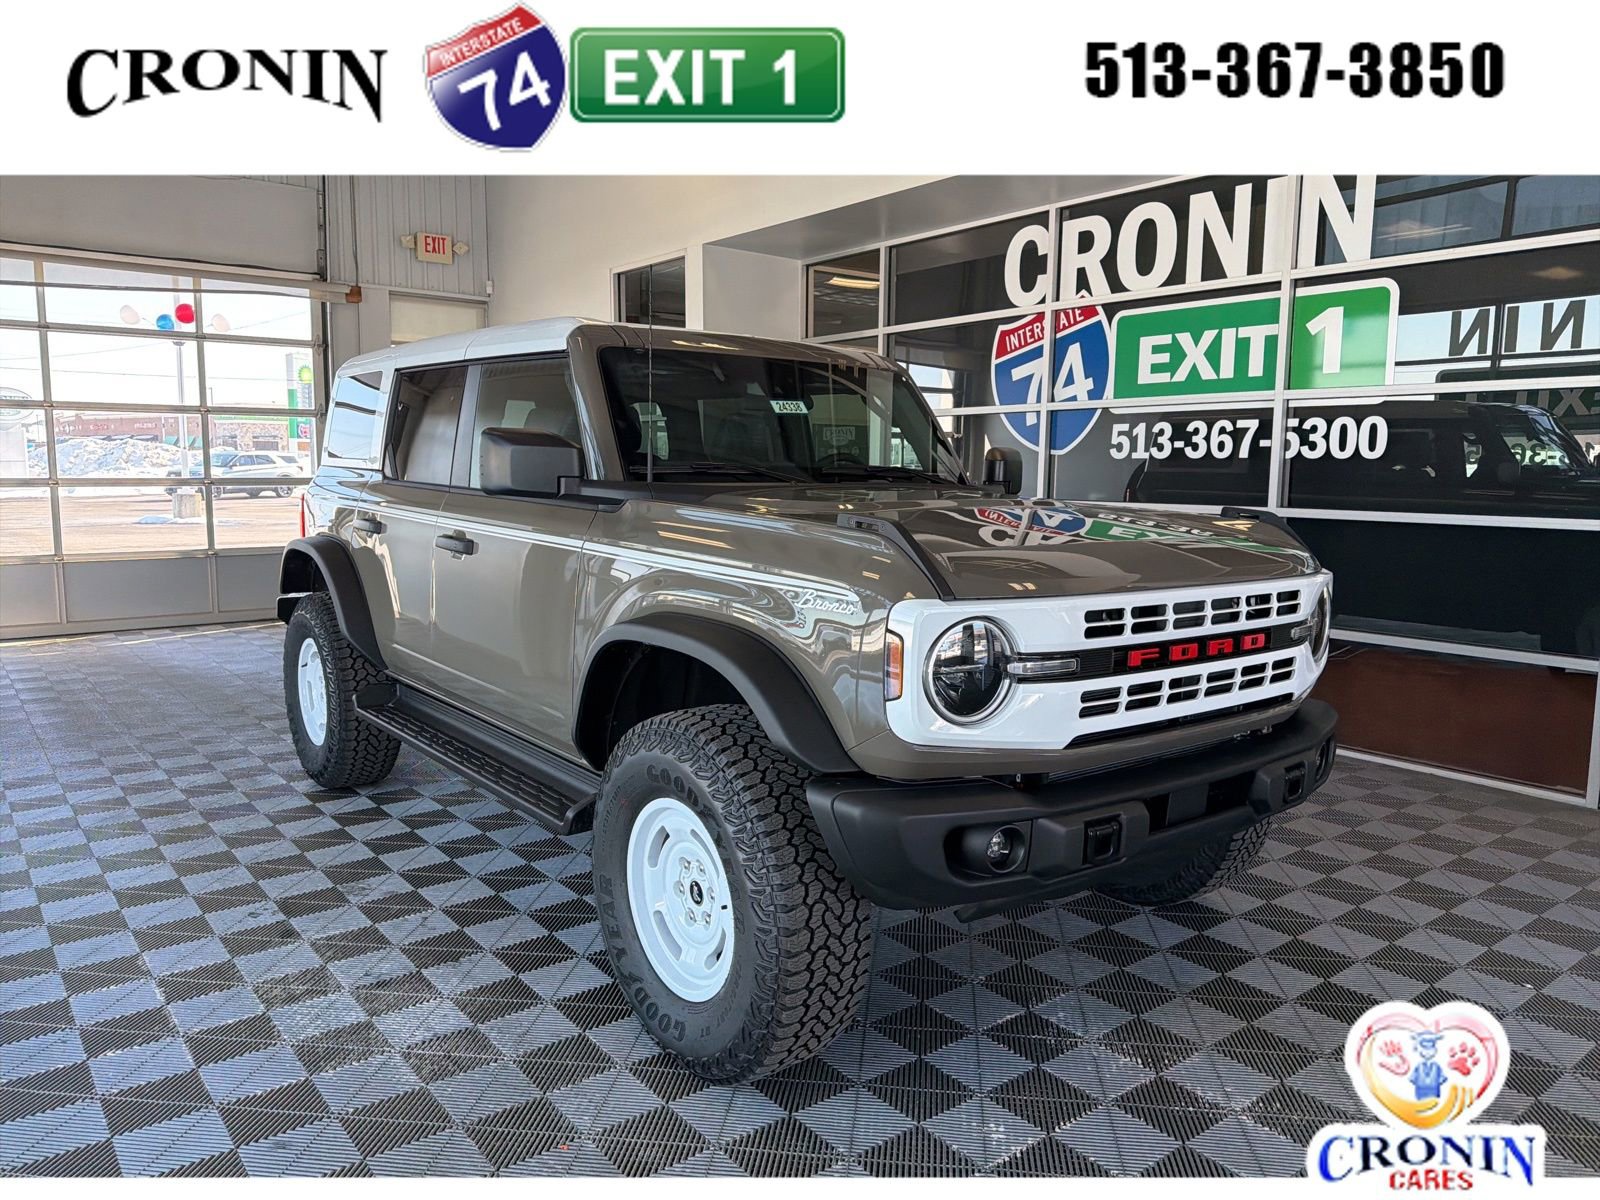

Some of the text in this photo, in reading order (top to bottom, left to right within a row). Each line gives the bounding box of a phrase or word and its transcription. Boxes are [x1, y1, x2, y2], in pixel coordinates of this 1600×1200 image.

[424, 235, 447, 256] EXIT
[1004, 175, 1377, 308] CRONIN
[1006, 308, 1085, 352] INTERATE
[1137, 306, 1345, 385] EXIT 1
[775, 401, 803, 412] 24338
[1011, 342, 1095, 427] 74
[1109, 415, 1389, 460] 513-367-5300
[795, 589, 857, 616] Bronco
[1127, 633, 1265, 667] FORD
